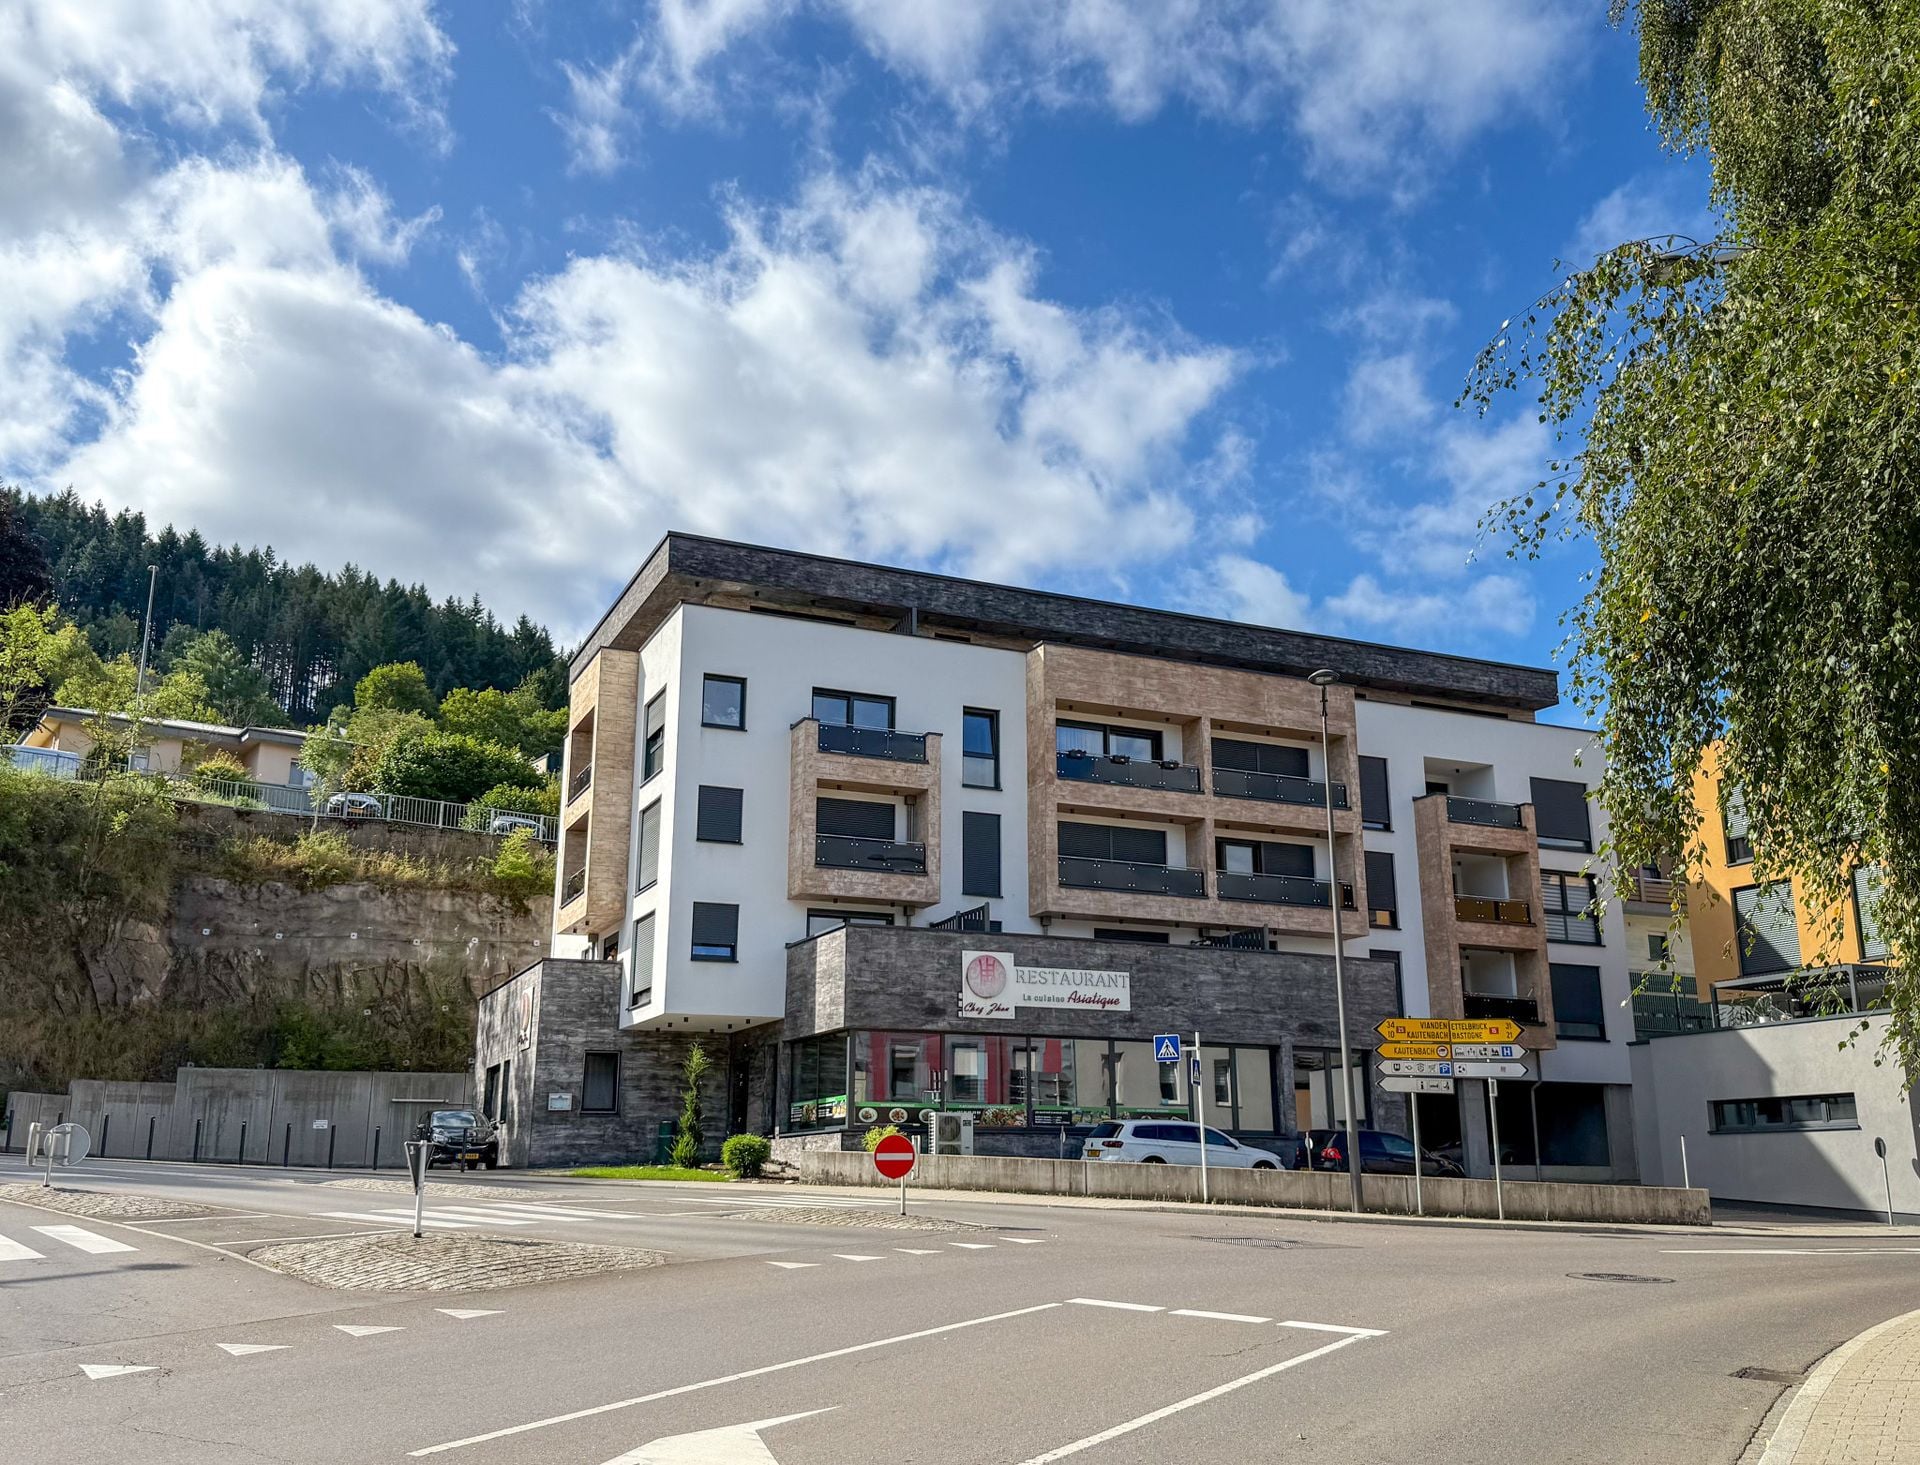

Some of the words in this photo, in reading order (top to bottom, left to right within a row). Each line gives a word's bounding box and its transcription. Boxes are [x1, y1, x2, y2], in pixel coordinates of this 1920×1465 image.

[1015, 968, 1129, 988] RESTAURANT
[1034, 994, 1065, 1002] cuisine
[1067, 990, 1121, 1009] Asiatique
[1386, 1021, 1395, 1029] 34
[1420, 1021, 1448, 1030] VIANDEN
[1451, 1023, 1488, 1031] ETTELBRUCK
[1407, 1031, 1449, 1039] KAUTENBACH
[1452, 1032, 1483, 1040] BASTOGNE
[1393, 1047, 1435, 1055] KAUTENBACH
